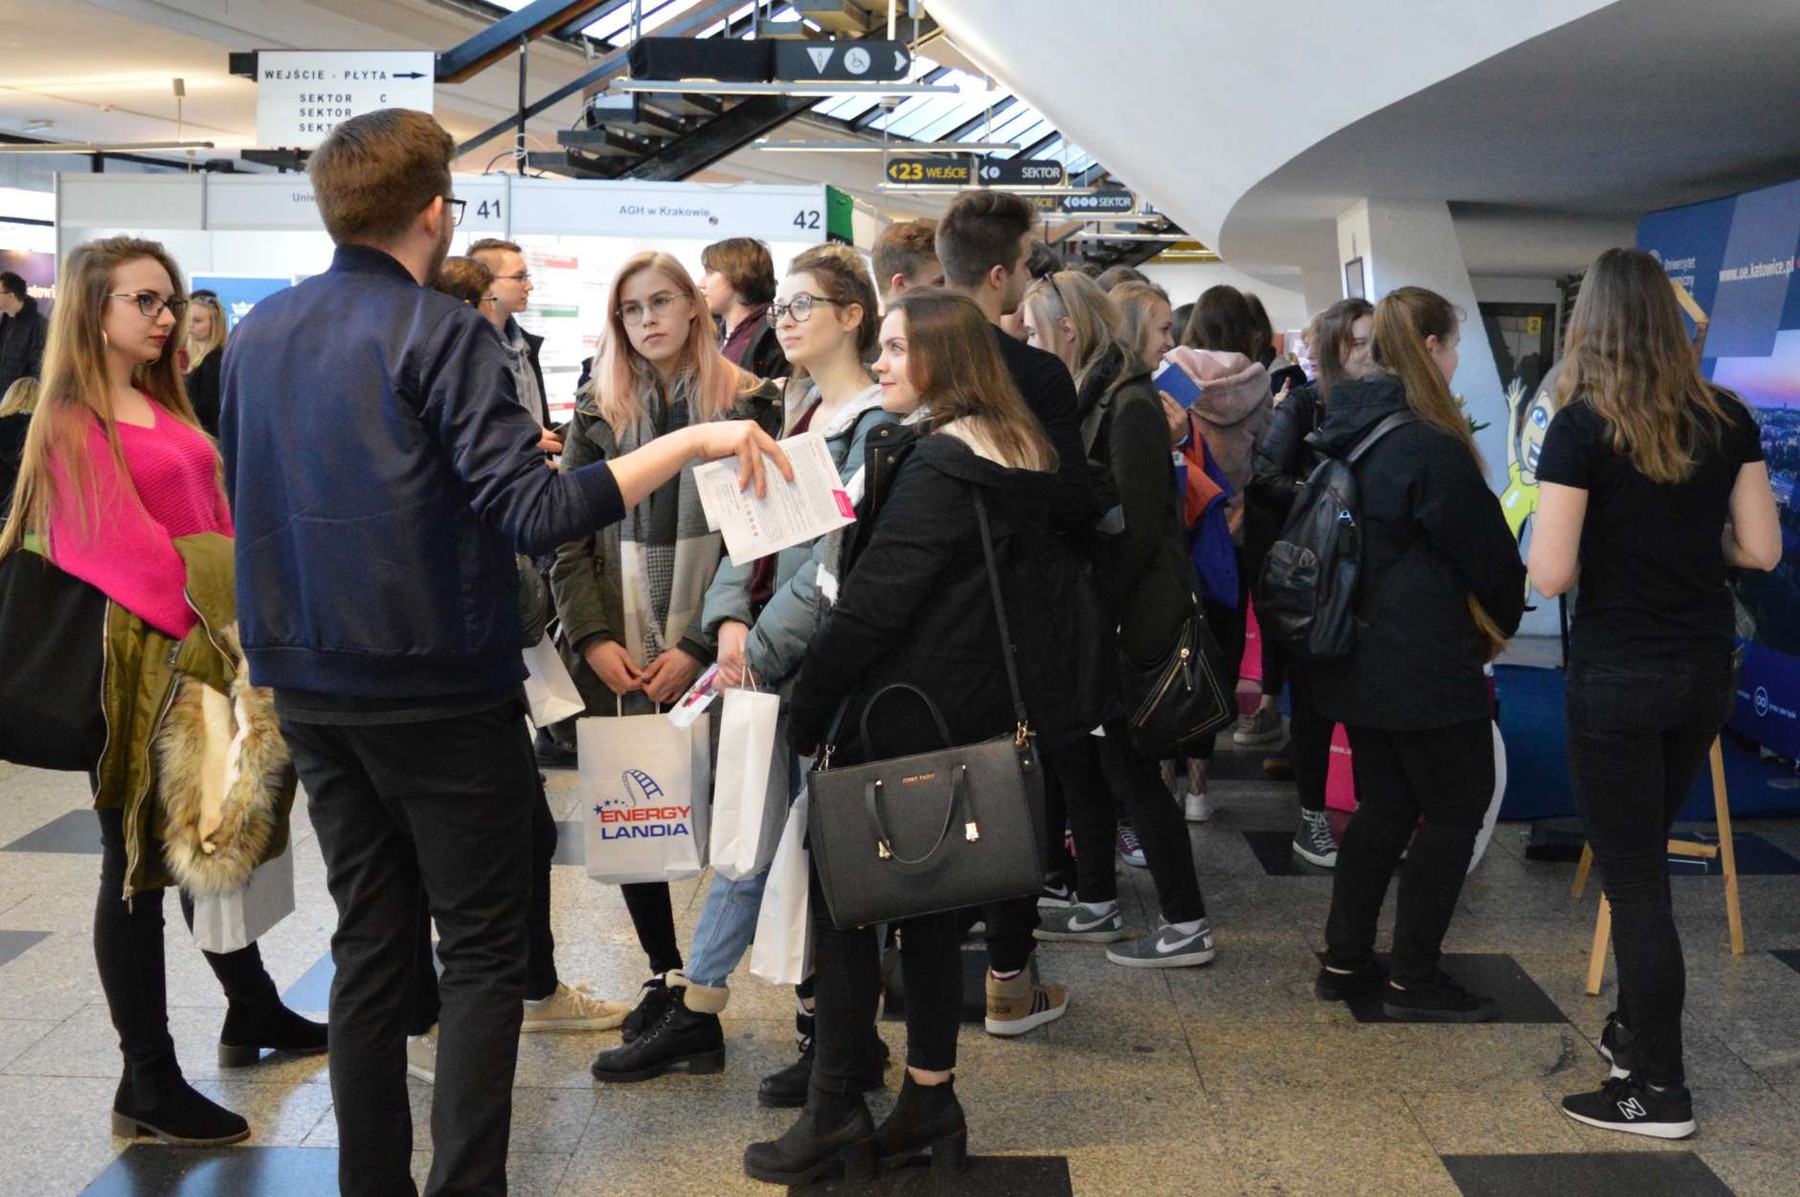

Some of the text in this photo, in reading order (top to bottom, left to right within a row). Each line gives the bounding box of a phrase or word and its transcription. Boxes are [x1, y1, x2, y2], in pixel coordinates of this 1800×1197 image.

[264, 68, 325, 80] WEJŚCIE
[344, 69, 387, 80] PŁYTA
[299, 93, 388, 104] SEKTOR C
[299, 108, 352, 117] SEKTOR
[298, 122, 332, 133] SEKT
[898, 162, 968, 180] 23 WEJŚCIE
[1021, 166, 1061, 179] SEKTOR
[476, 199, 502, 219] 41
[1098, 197, 1132, 208] SEKTOR
[619, 205, 711, 218] AGH w Krakowie
[792, 210, 821, 230] 42
[600, 806, 691, 823] ENERGY
[601, 823, 689, 840] LANDIA
